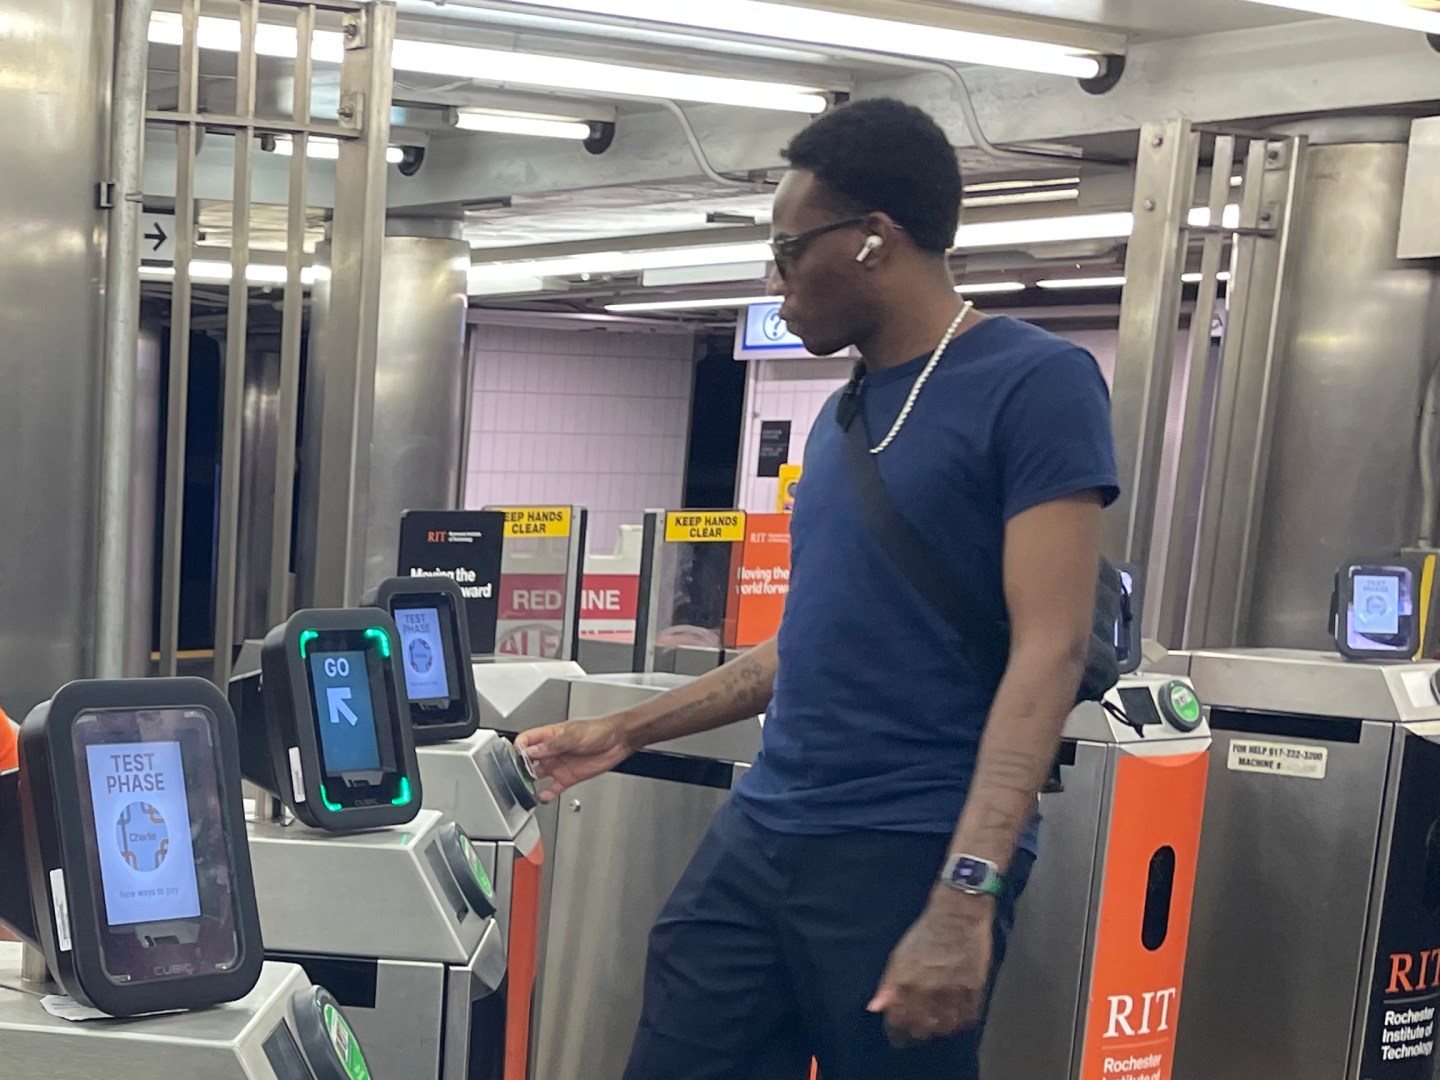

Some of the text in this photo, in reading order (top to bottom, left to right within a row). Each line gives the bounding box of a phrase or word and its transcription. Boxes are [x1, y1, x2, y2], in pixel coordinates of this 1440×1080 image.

[505, 511, 563, 522] EEP HANDS
[675, 516, 738, 526] KEEP HANDS
[427, 531, 447, 543] RIT
[511, 523, 546, 534] CLEAR
[689, 528, 722, 538] CLEAR
[750, 533, 766, 543] RIT
[456, 566, 476, 583] the
[773, 566, 790, 580] the
[513, 589, 620, 610] RED INE
[324, 657, 350, 678] GO
[110, 753, 155, 773] TEST
[106, 773, 166, 793] PHASE
[129, 832, 157, 843] Charlie
[137, 888, 156, 899] ways
[157, 886, 164, 896] to
[166, 885, 179, 897] pay
[1385, 948, 1440, 994] RIT
[1103, 987, 1176, 1038] RIT
[1384, 1006, 1435, 1026] Rochester
[1382, 1020, 1434, 1043] Institute of
[1381, 1040, 1434, 1061] Technology
[1103, 1053, 1162, 1074] Rochester
